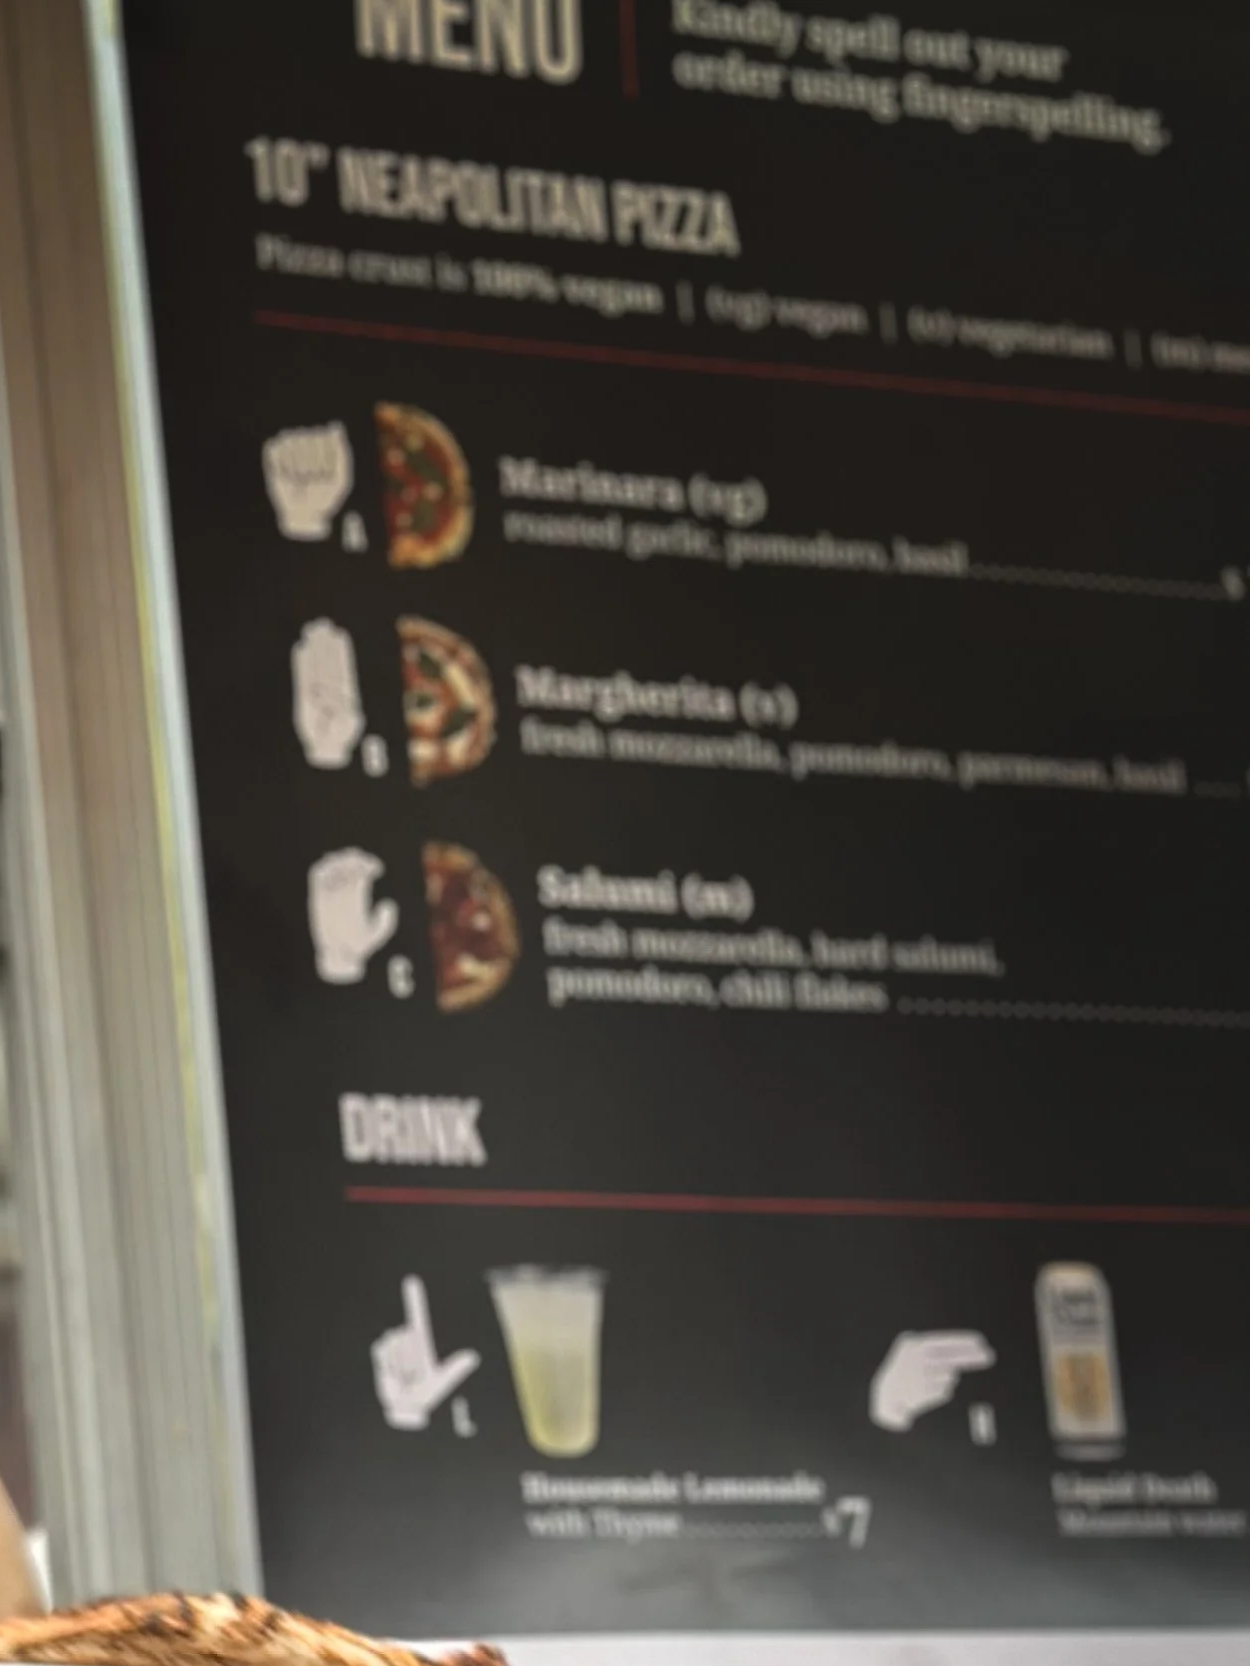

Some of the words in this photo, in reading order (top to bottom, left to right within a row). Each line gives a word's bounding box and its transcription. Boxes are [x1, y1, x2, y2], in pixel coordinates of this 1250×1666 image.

[355, 0, 582, 85] MENU
[806, 14, 901, 62] spell
[904, 28, 971, 70] out
[973, 37, 1068, 82] your
[673, 50, 785, 98] order
[791, 66, 901, 123] using
[337, 147, 611, 243] NEAPOLITAN
[612, 180, 740, 257] PIZZA
[560, 274, 665, 318] vegan
[498, 455, 685, 513] Marinara
[514, 662, 736, 723] Margherita
[519, 713, 605, 759] fresh
[543, 914, 629, 957] fresh
[338, 1091, 488, 1167] DRINK
